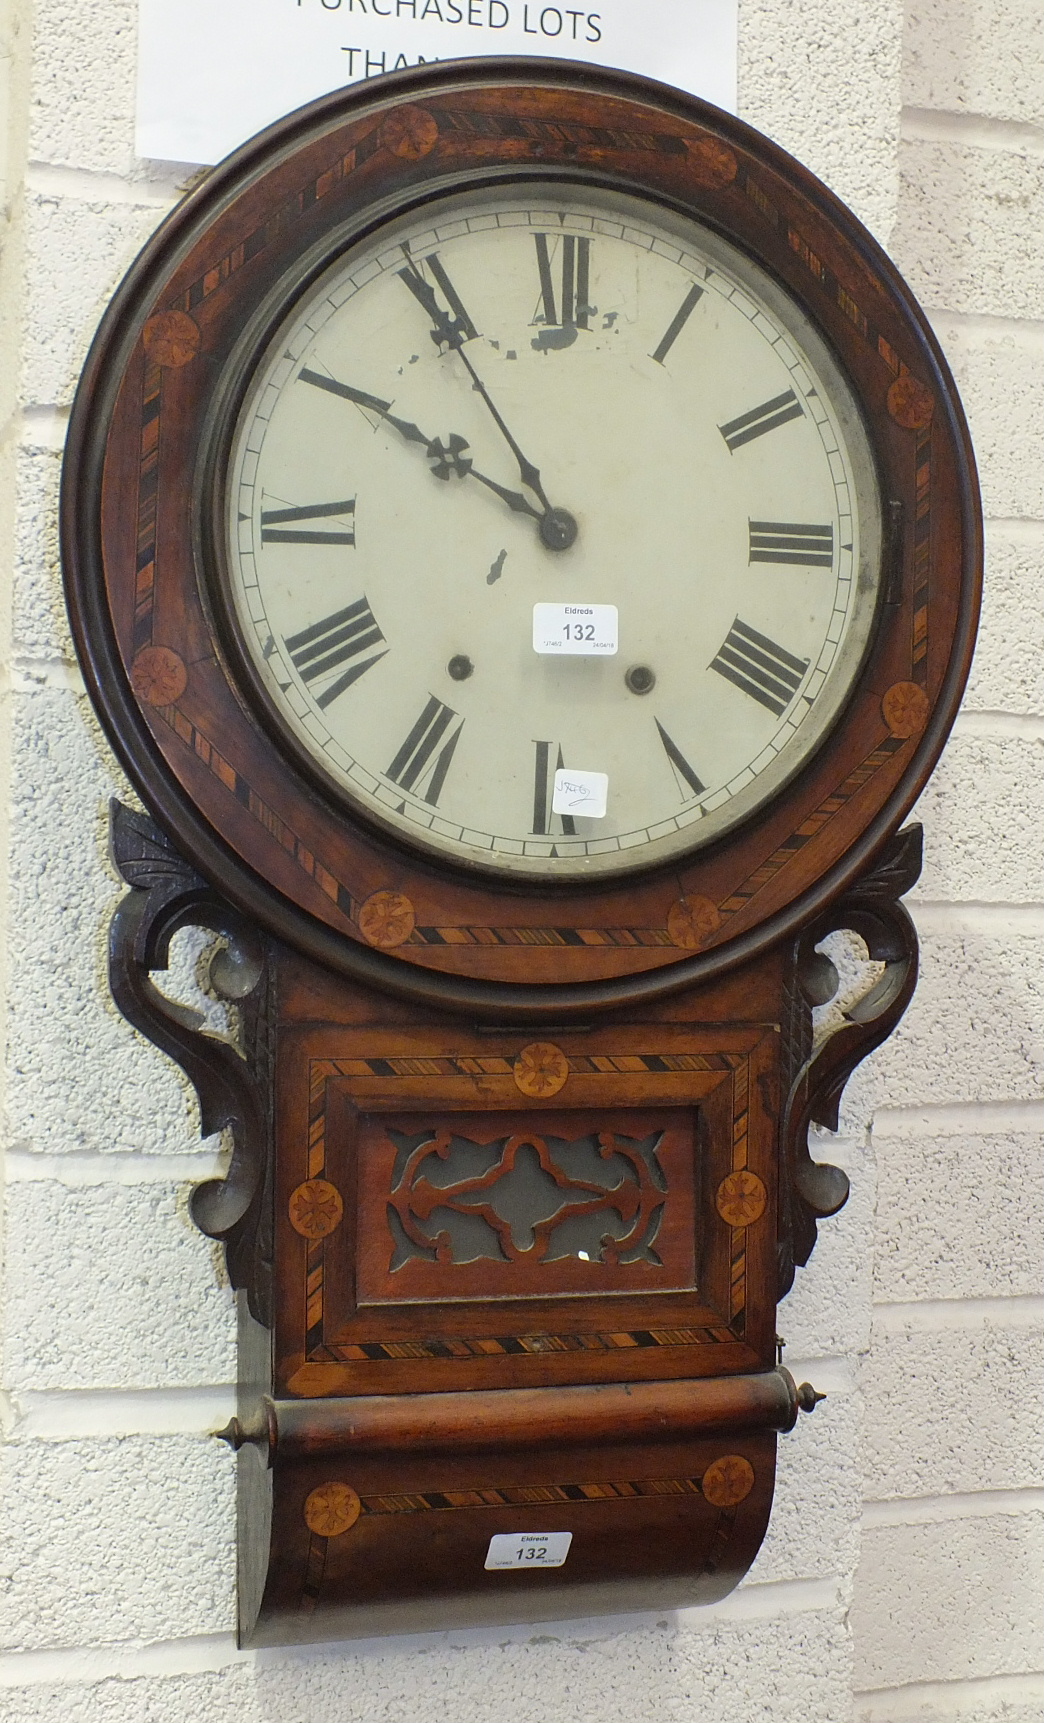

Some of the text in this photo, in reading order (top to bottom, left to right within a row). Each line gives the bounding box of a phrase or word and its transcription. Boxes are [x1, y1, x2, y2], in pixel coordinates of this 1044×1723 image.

[524, 4, 602, 42] LOTS
[527, 232, 595, 332] XII
[653, 280, 710, 368] I
[716, 384, 807, 456] II
[261, 487, 357, 550] IX
[748, 516, 833, 573] III
[562, 624, 595, 641] 132
[564, 607, 593, 615] Eldreds
[280, 593, 391, 716] VIII
[706, 613, 811, 721] IIII
[380, 692, 466, 809] VII
[654, 715, 710, 805] V
[516, 1547, 547, 1561] 132
